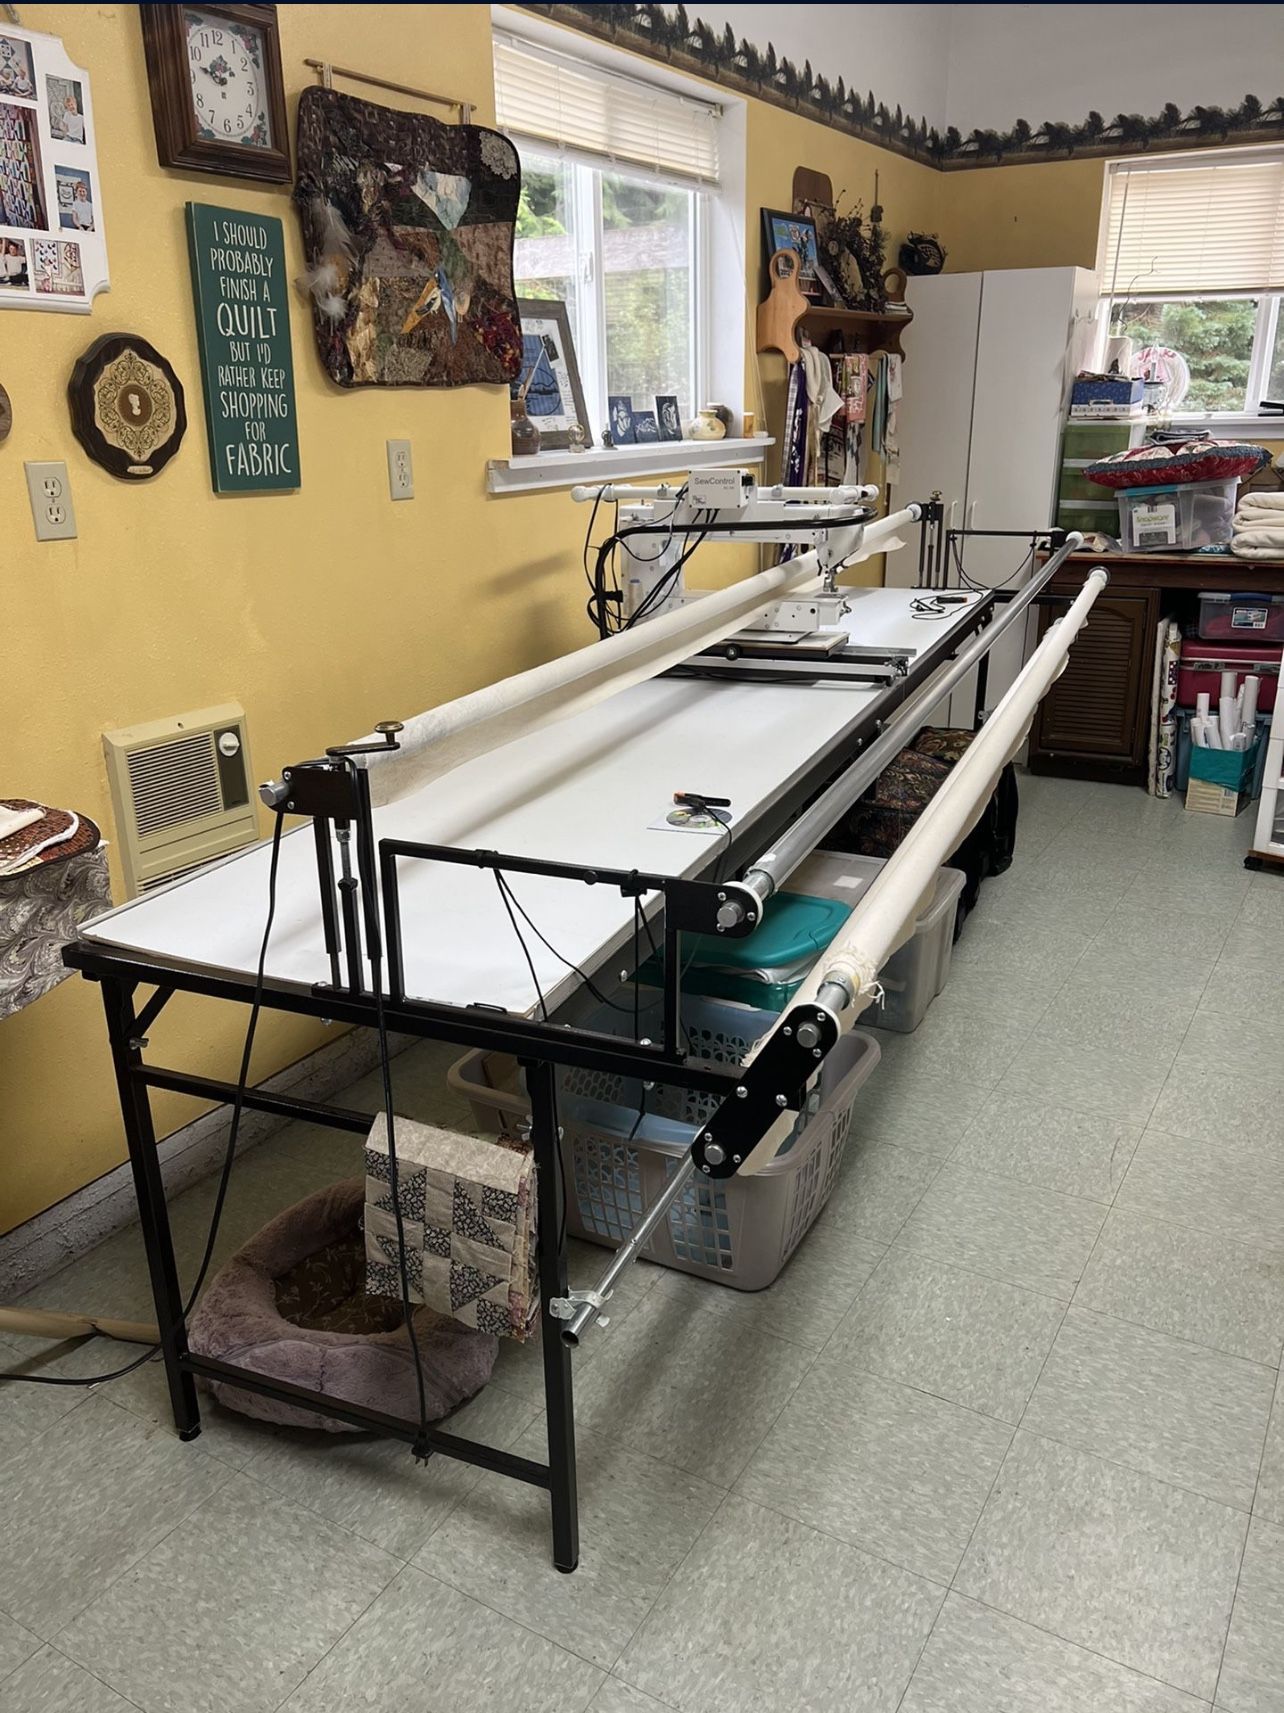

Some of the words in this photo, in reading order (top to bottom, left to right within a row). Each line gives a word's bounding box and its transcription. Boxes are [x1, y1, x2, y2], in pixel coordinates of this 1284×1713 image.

[200, 32, 209, 48] 11
[211, 29, 223, 46] 12
[190, 45, 201, 62] 10
[232, 40, 236, 54] 1
[240, 57, 248, 72] 2
[246, 81, 254, 96] 3
[196, 93, 204, 108] 8
[208, 109, 216, 124] 7
[245, 103, 253, 118] 4
[223, 118, 231, 133] 6
[236, 114, 244, 129] 5
[213, 221, 219, 241] I
[223, 221, 267, 250] SHOULD
[210, 247, 273, 278] PROBABLY
[220, 276, 257, 301] FINISH
[263, 280, 271, 302] A
[217, 302, 277, 339] QUILT
[229, 341, 250, 362] BUT
[257, 343, 271, 365] I'D
[218, 365, 256, 387] RATHER
[260, 366, 286, 390] KEEP
[220, 391, 288, 419] SHOPPING
[244, 421, 266, 442] FOR
[226, 442, 292, 476] FABRIC
[694, 477, 735, 485] SewControl
